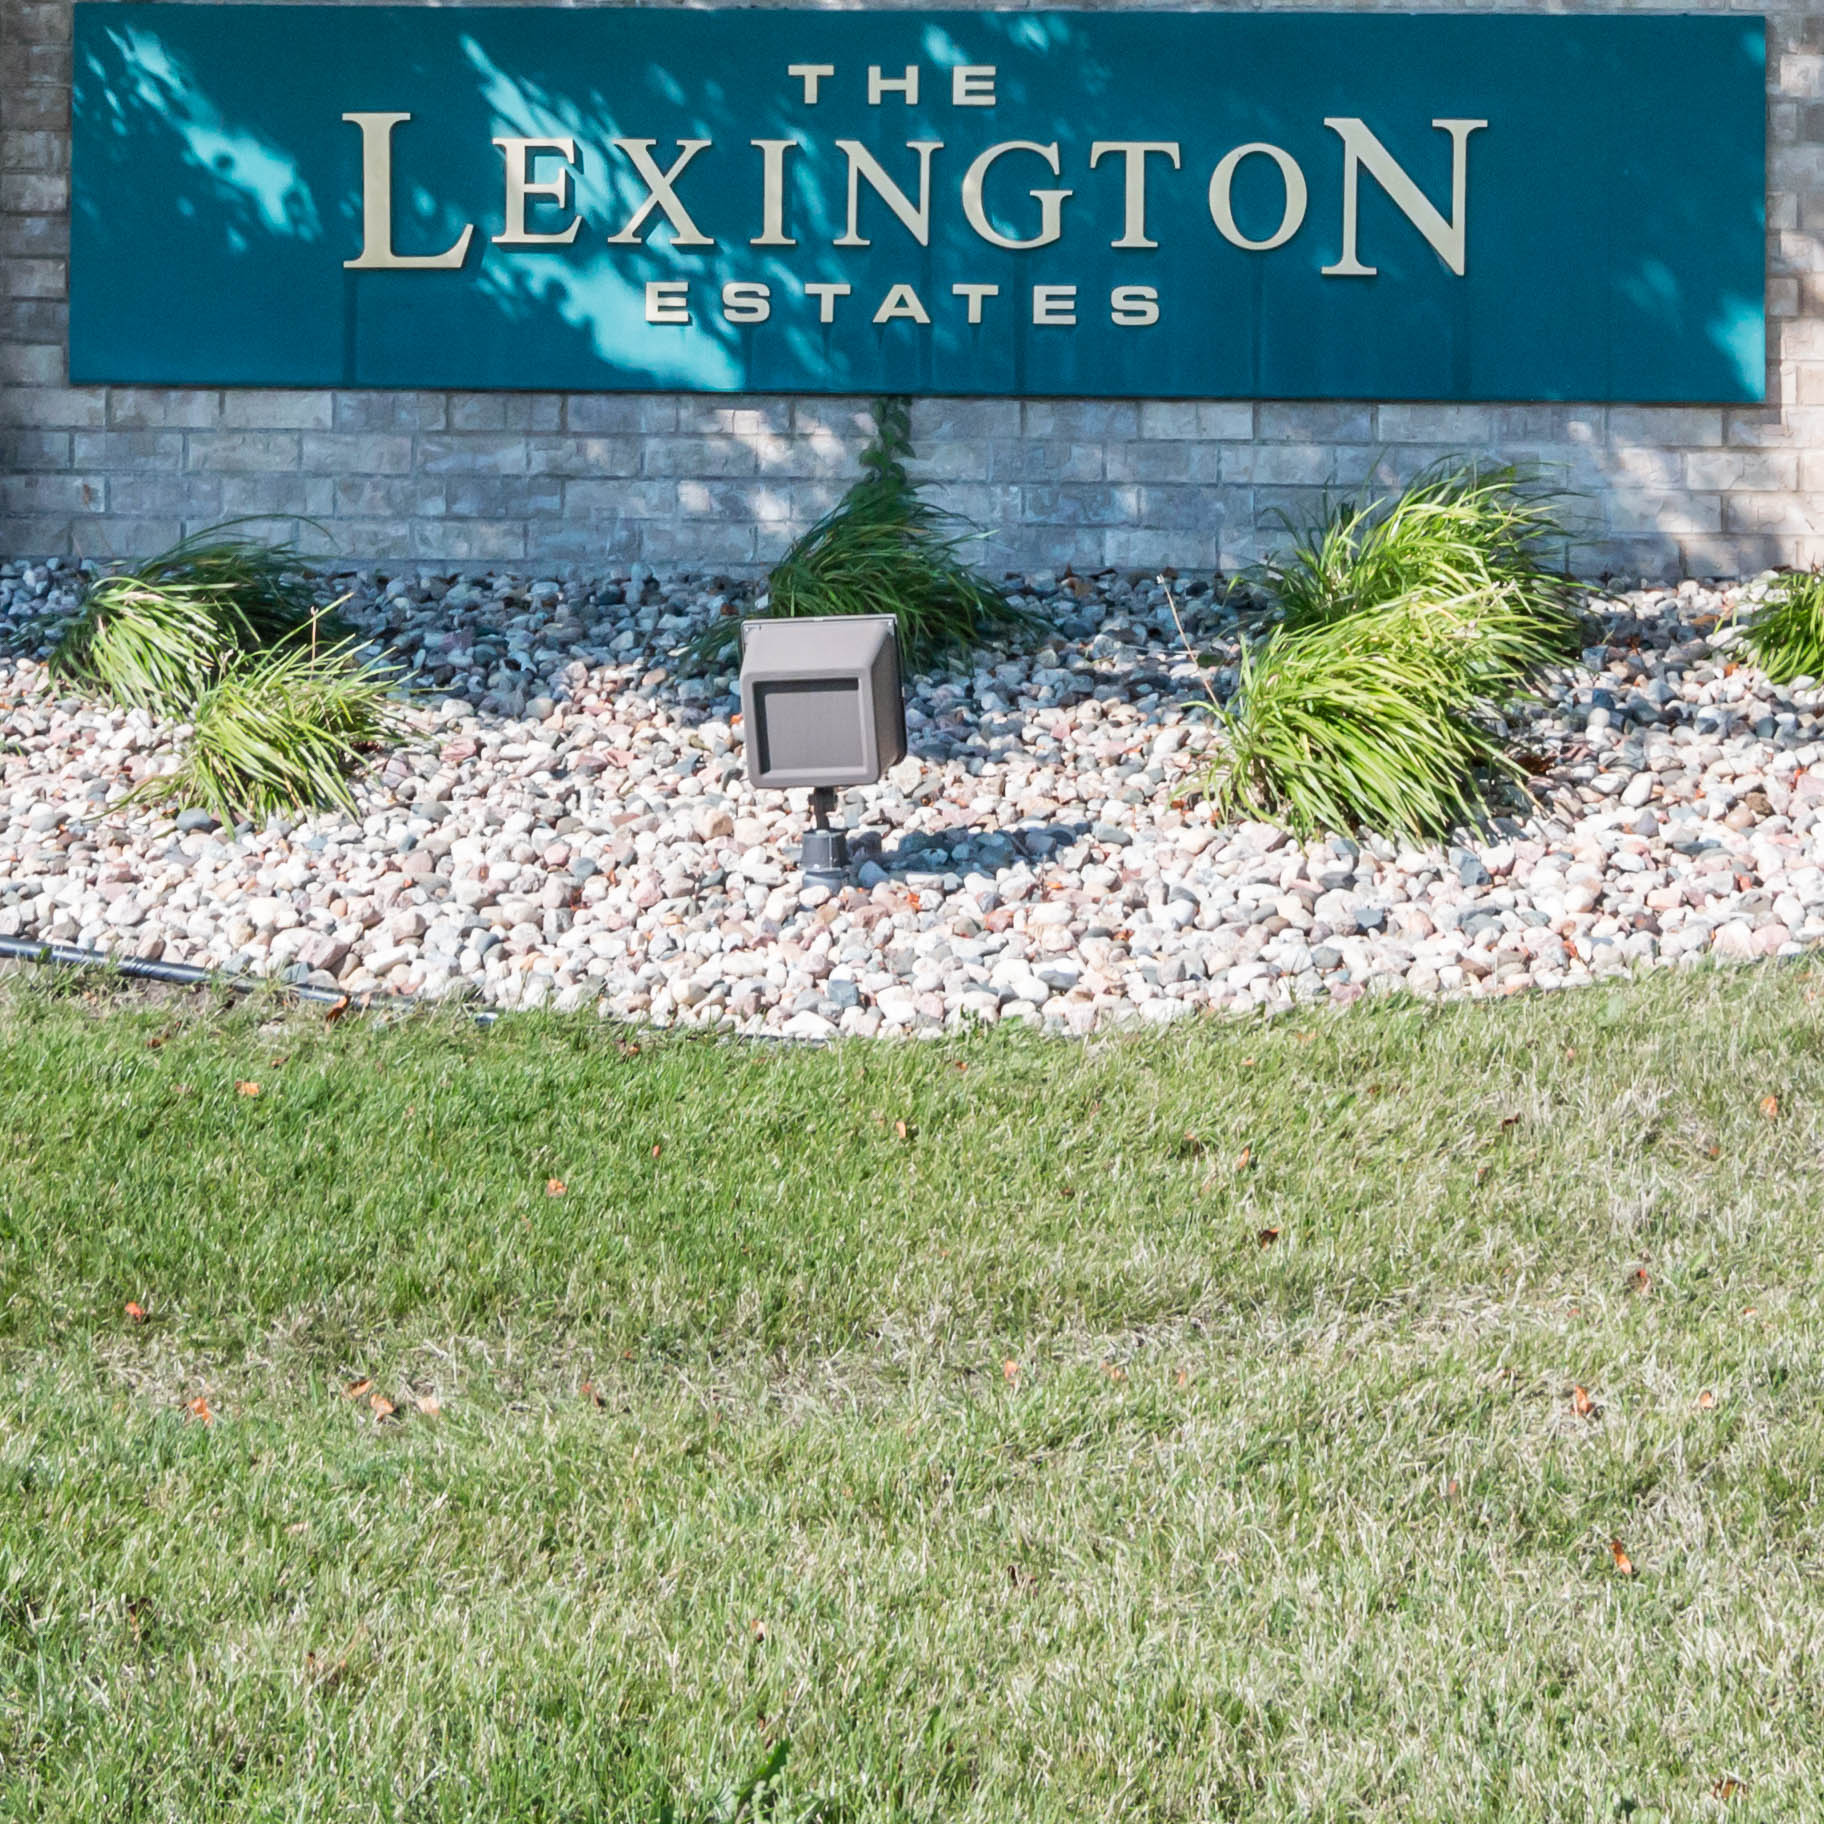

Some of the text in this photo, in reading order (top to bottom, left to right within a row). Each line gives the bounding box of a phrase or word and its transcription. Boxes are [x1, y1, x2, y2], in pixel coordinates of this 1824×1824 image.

[788, 64, 997, 106] THE
[341, 111, 1489, 277] LEXINGTON
[645, 281, 1161, 326] ESTATES
